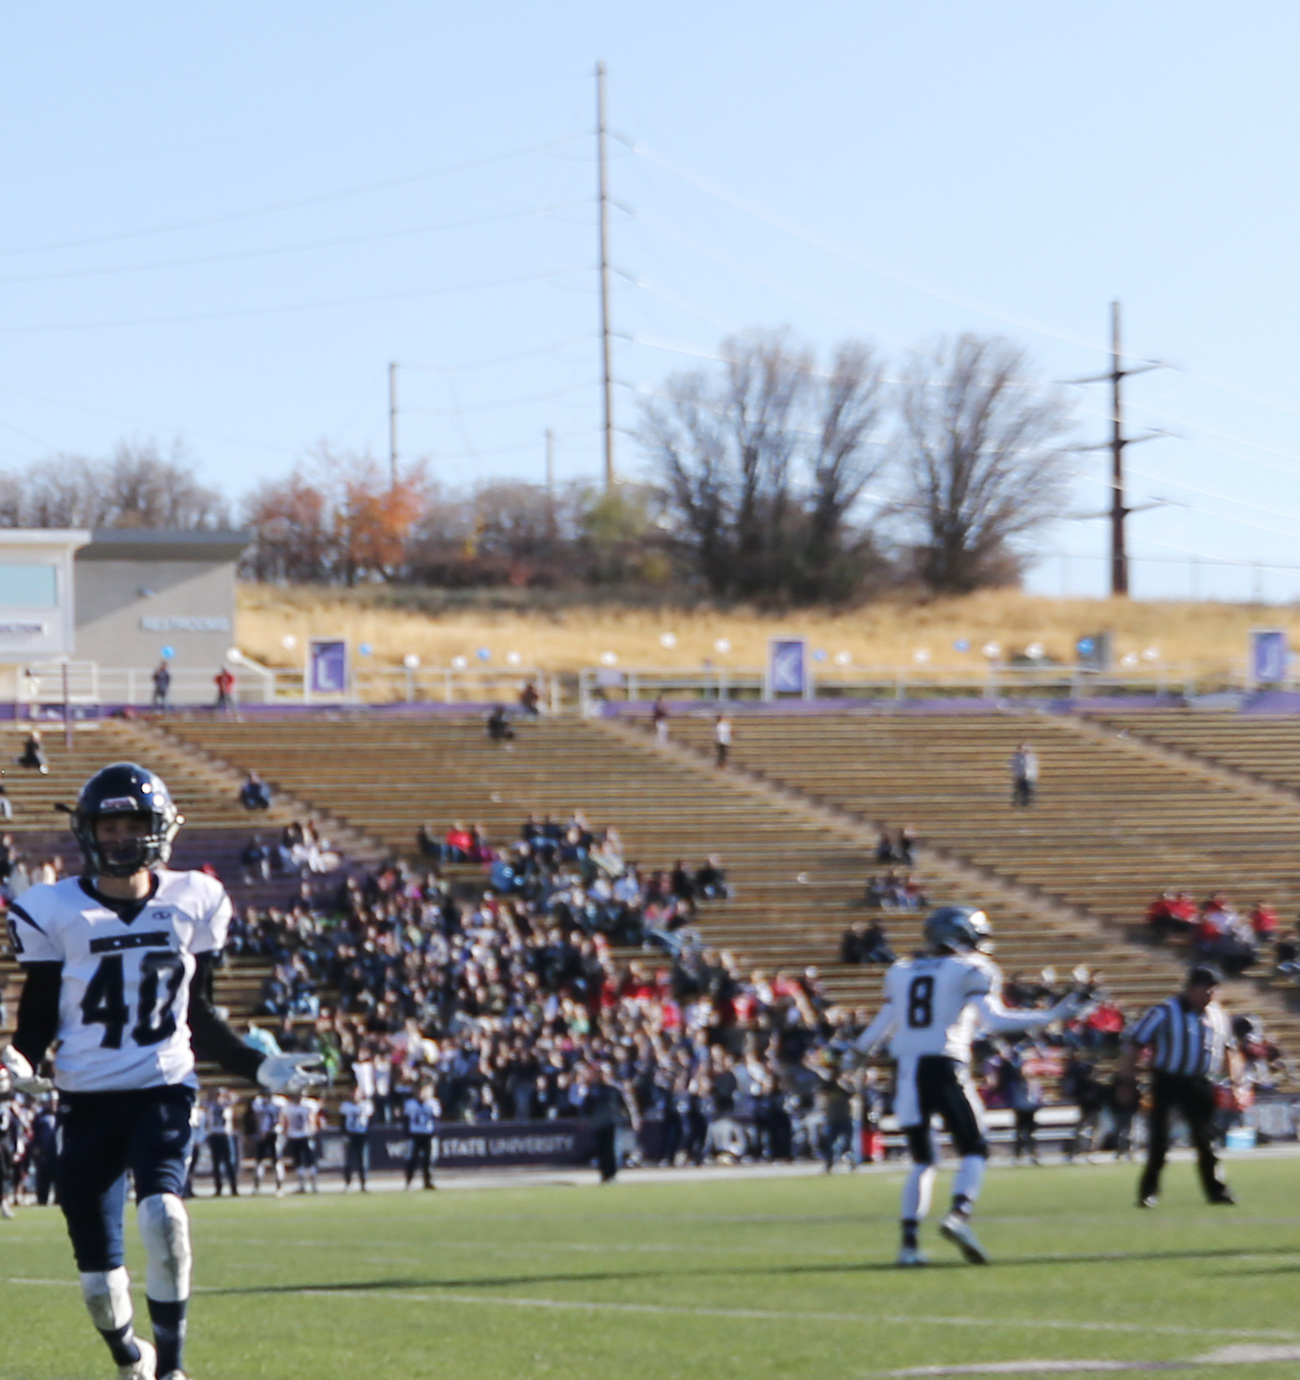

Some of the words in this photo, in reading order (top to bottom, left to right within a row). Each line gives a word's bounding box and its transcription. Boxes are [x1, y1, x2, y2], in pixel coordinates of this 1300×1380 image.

[317, 658, 336, 689] L
[80, 953, 186, 1049] 40
[908, 975, 934, 1029] 8
[442, 1136, 486, 1158] STATE
[489, 1135, 574, 1156] UNIVERSITY
